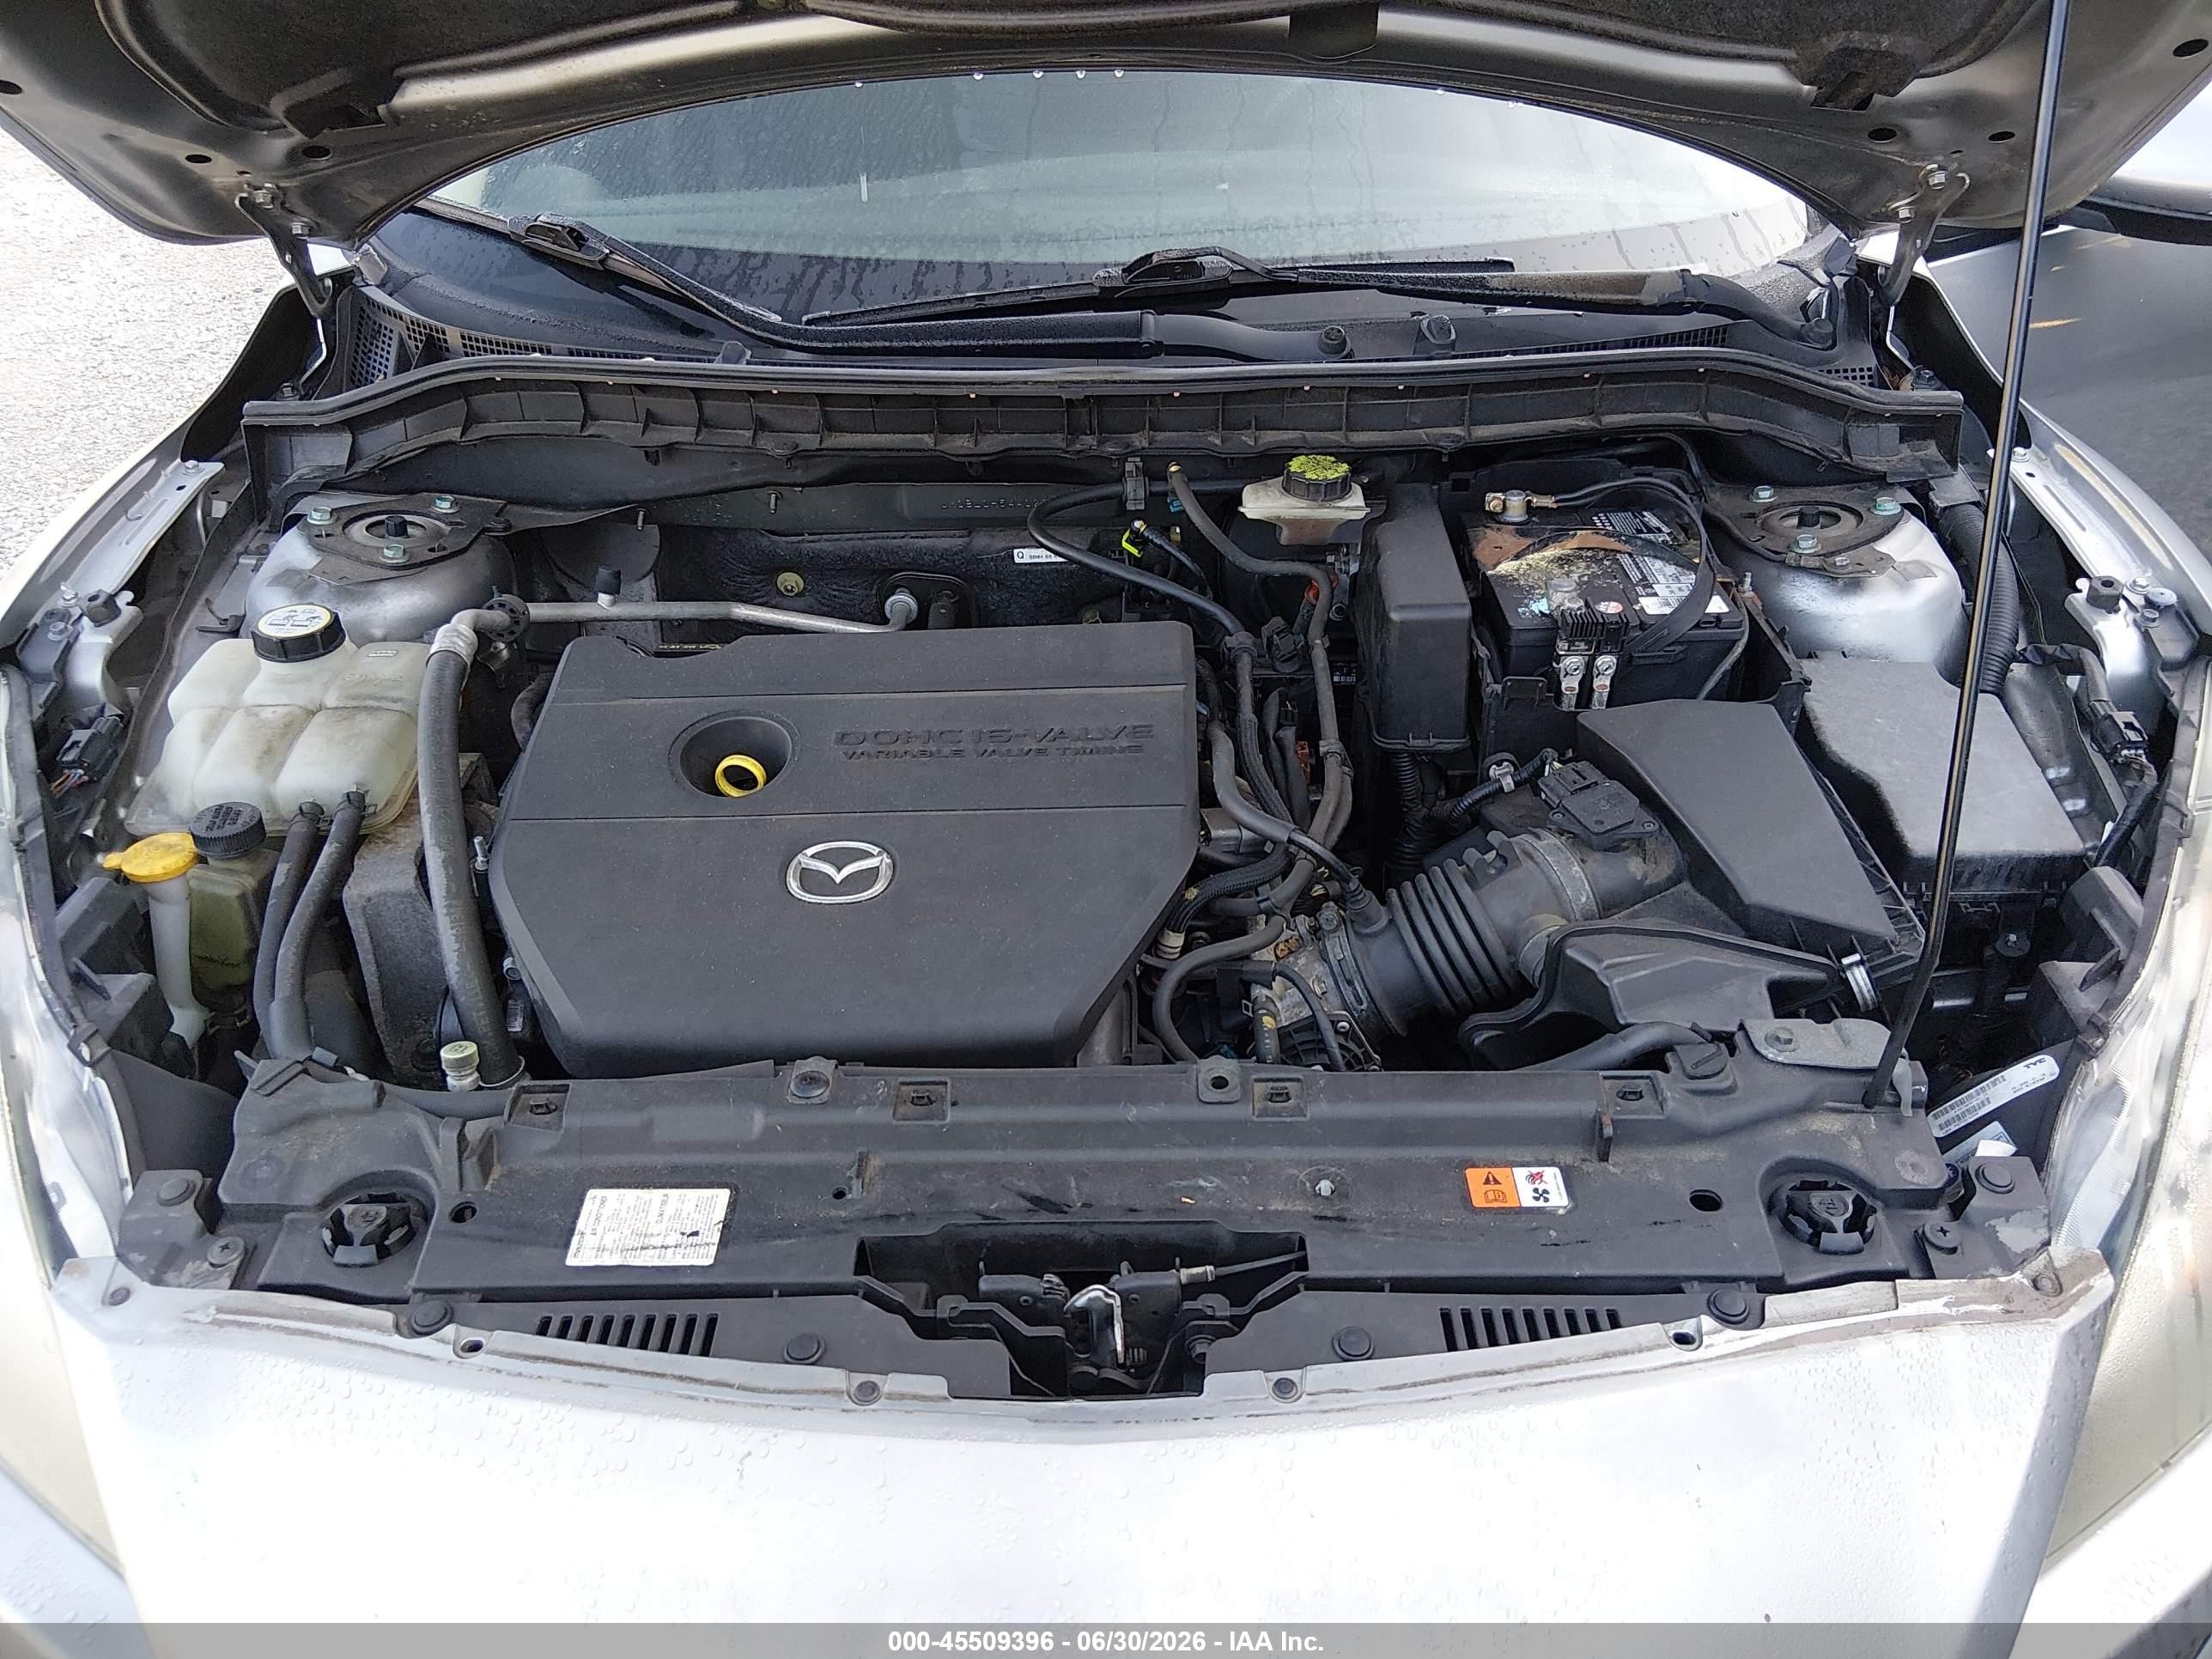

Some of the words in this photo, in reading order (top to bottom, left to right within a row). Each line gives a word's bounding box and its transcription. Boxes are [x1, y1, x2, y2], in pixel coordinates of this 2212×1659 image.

[1017, 550, 1024, 560] Q
[836, 730, 963, 746] DOHC
[971, 725, 1154, 744] 16-VALVE
[842, 749, 965, 760] VARIABLE
[975, 748, 1049, 758] VALVE
[1056, 744, 1146, 757] TIMING
[2023, 1057, 2047, 1069] TYC
